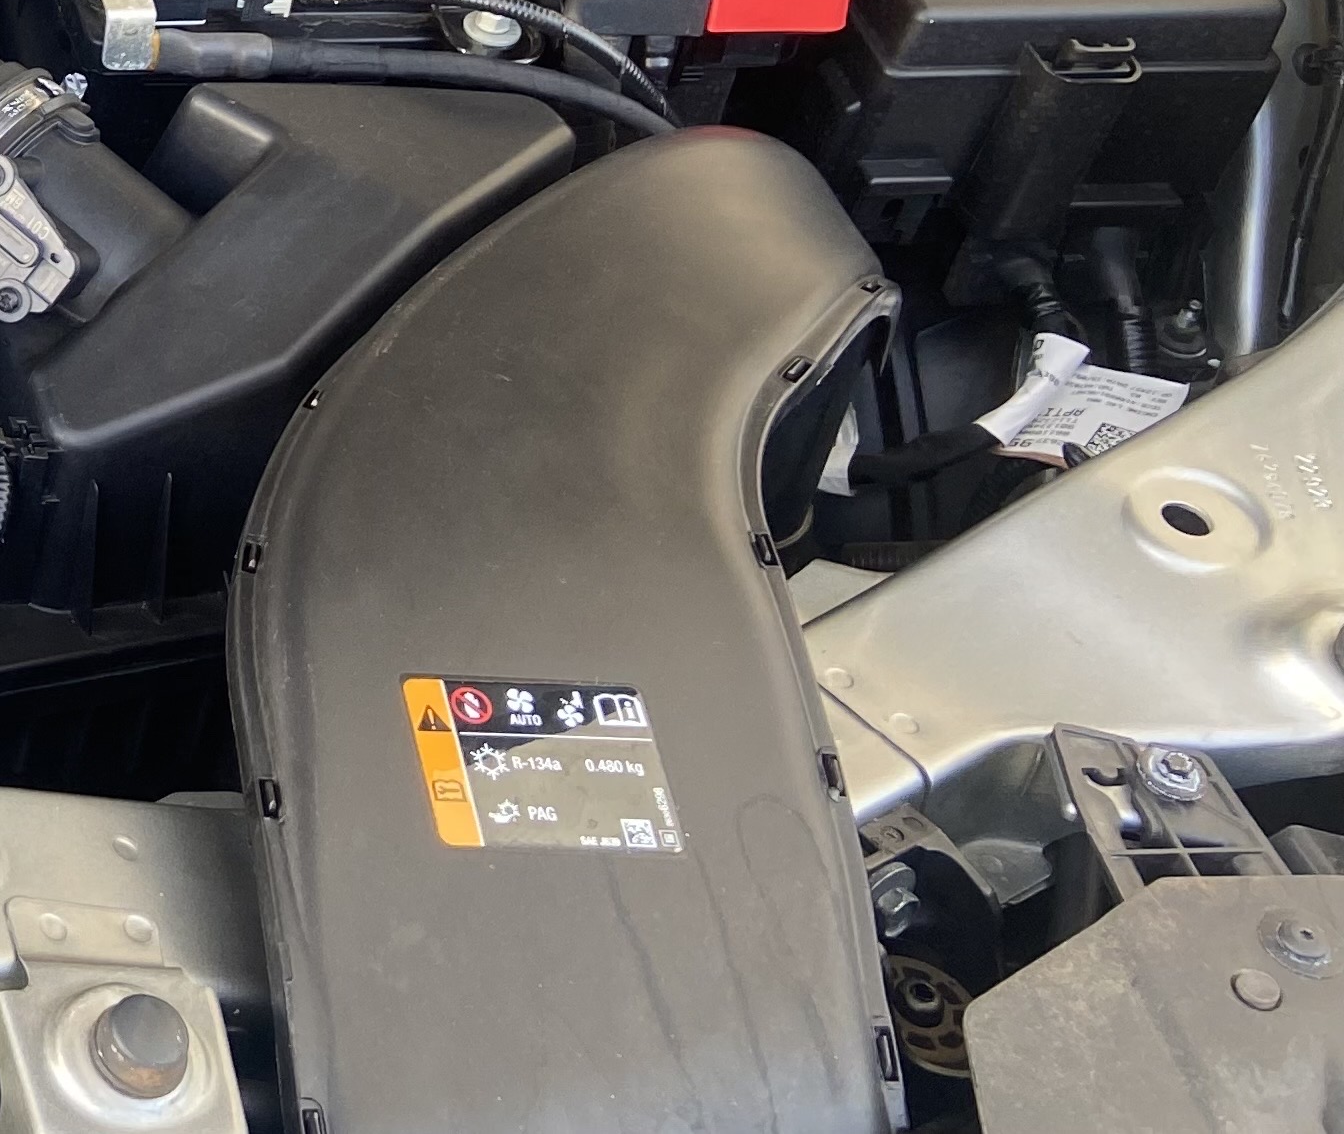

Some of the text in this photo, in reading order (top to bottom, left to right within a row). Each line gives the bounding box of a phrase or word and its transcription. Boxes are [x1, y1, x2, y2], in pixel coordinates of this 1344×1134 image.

[509, 713, 543, 727] AUTO
[512, 755, 645, 777] R-134a 0.480 kg
[528, 806, 558, 822] PAG
